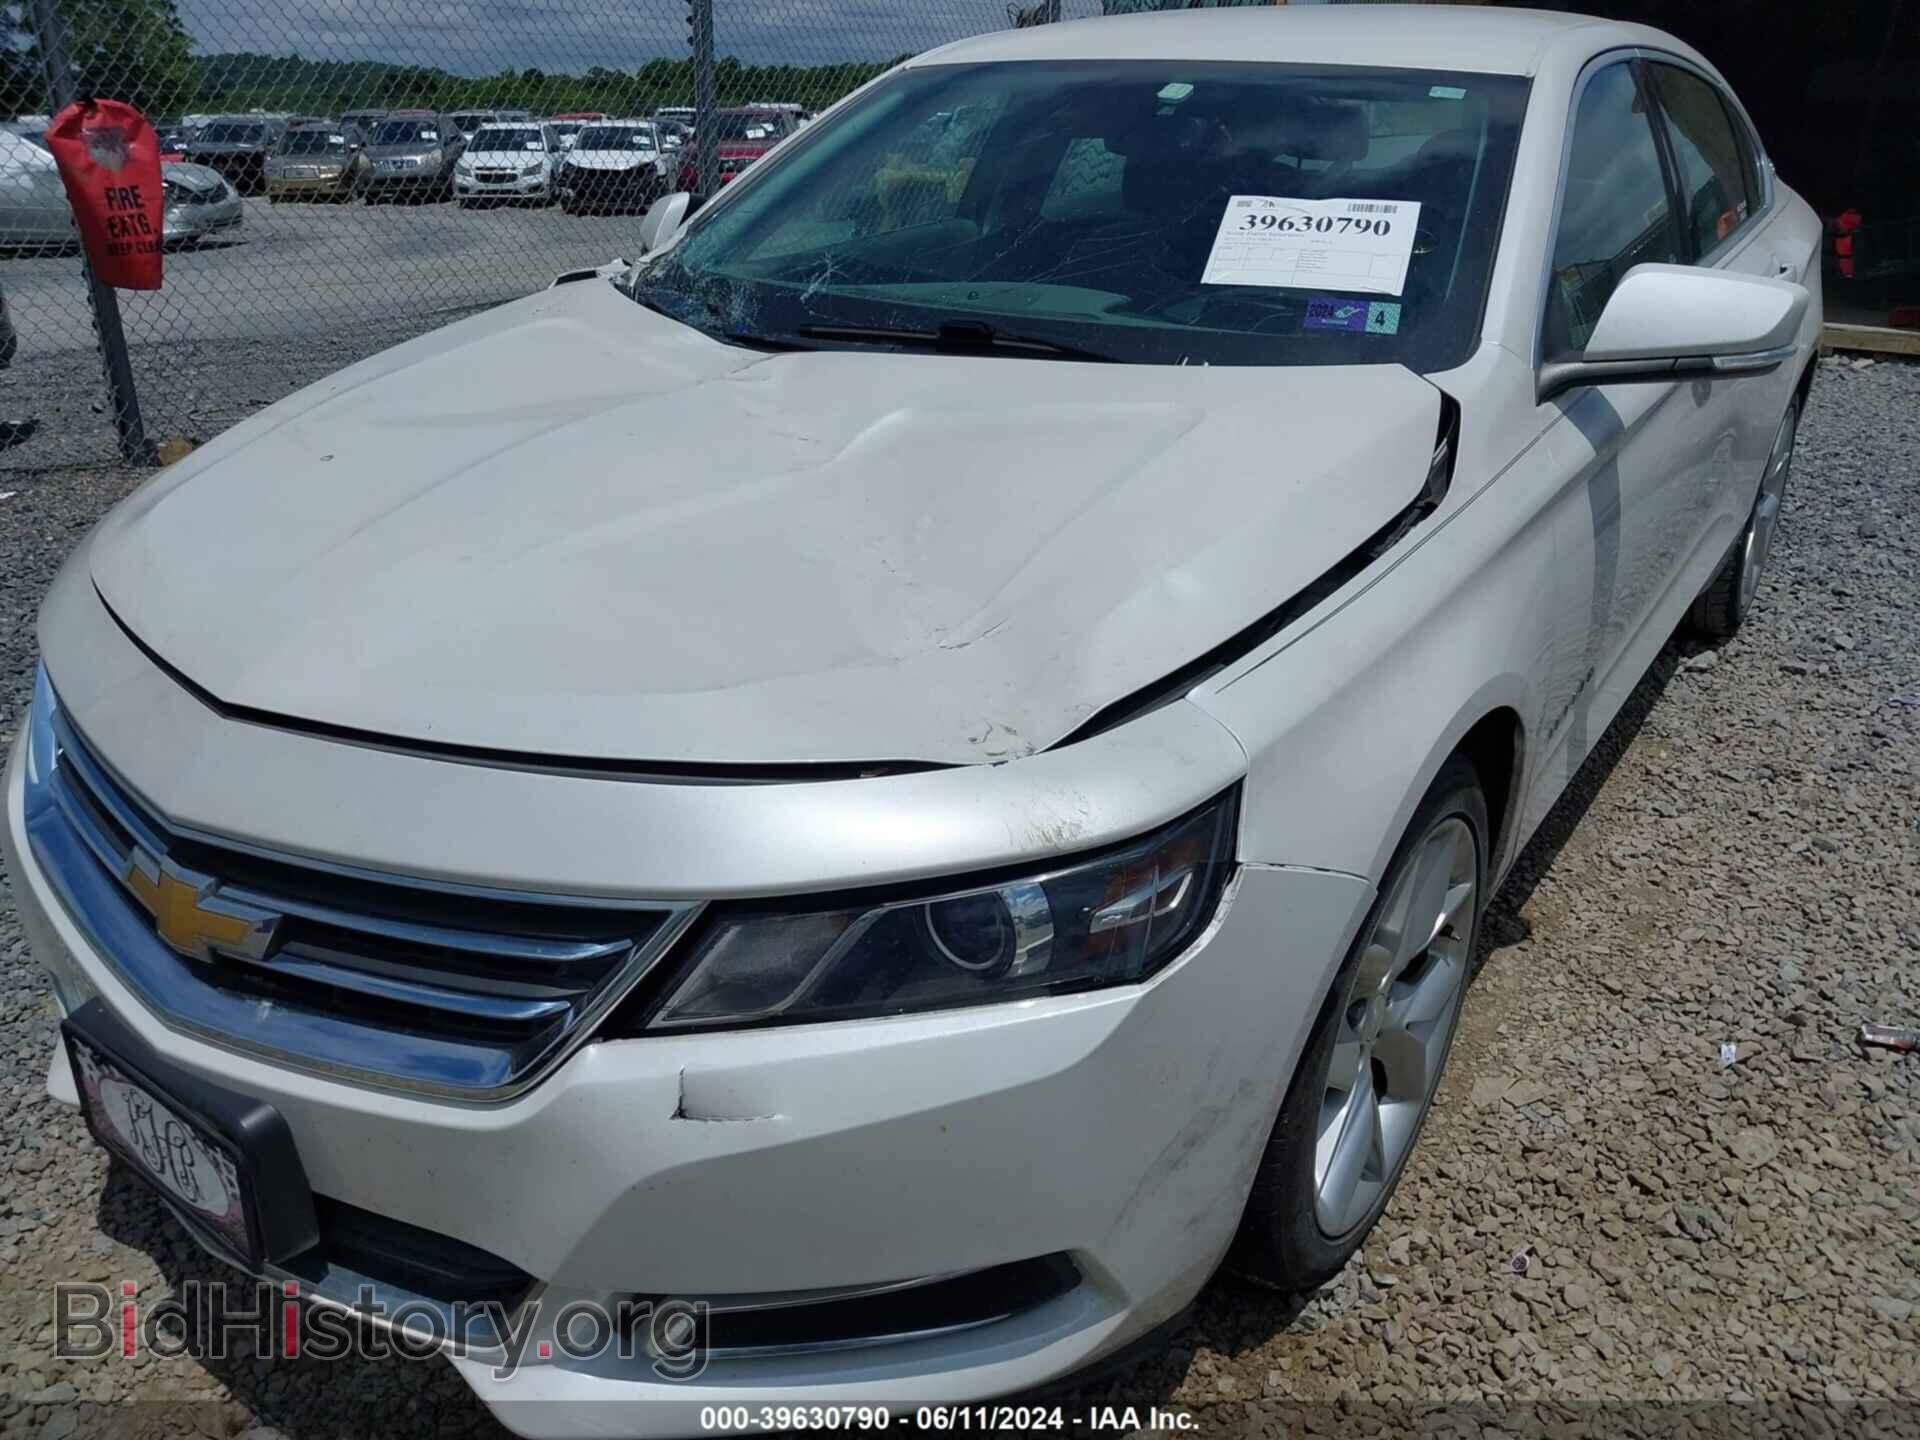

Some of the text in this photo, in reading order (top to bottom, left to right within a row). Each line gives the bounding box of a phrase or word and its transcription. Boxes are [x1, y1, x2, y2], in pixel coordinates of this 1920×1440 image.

[104, 185, 145, 210] FIRE
[107, 212, 159, 238] EXTG.
[1238, 213, 1391, 237] 39630790
[1374, 310, 1386, 327] 4
